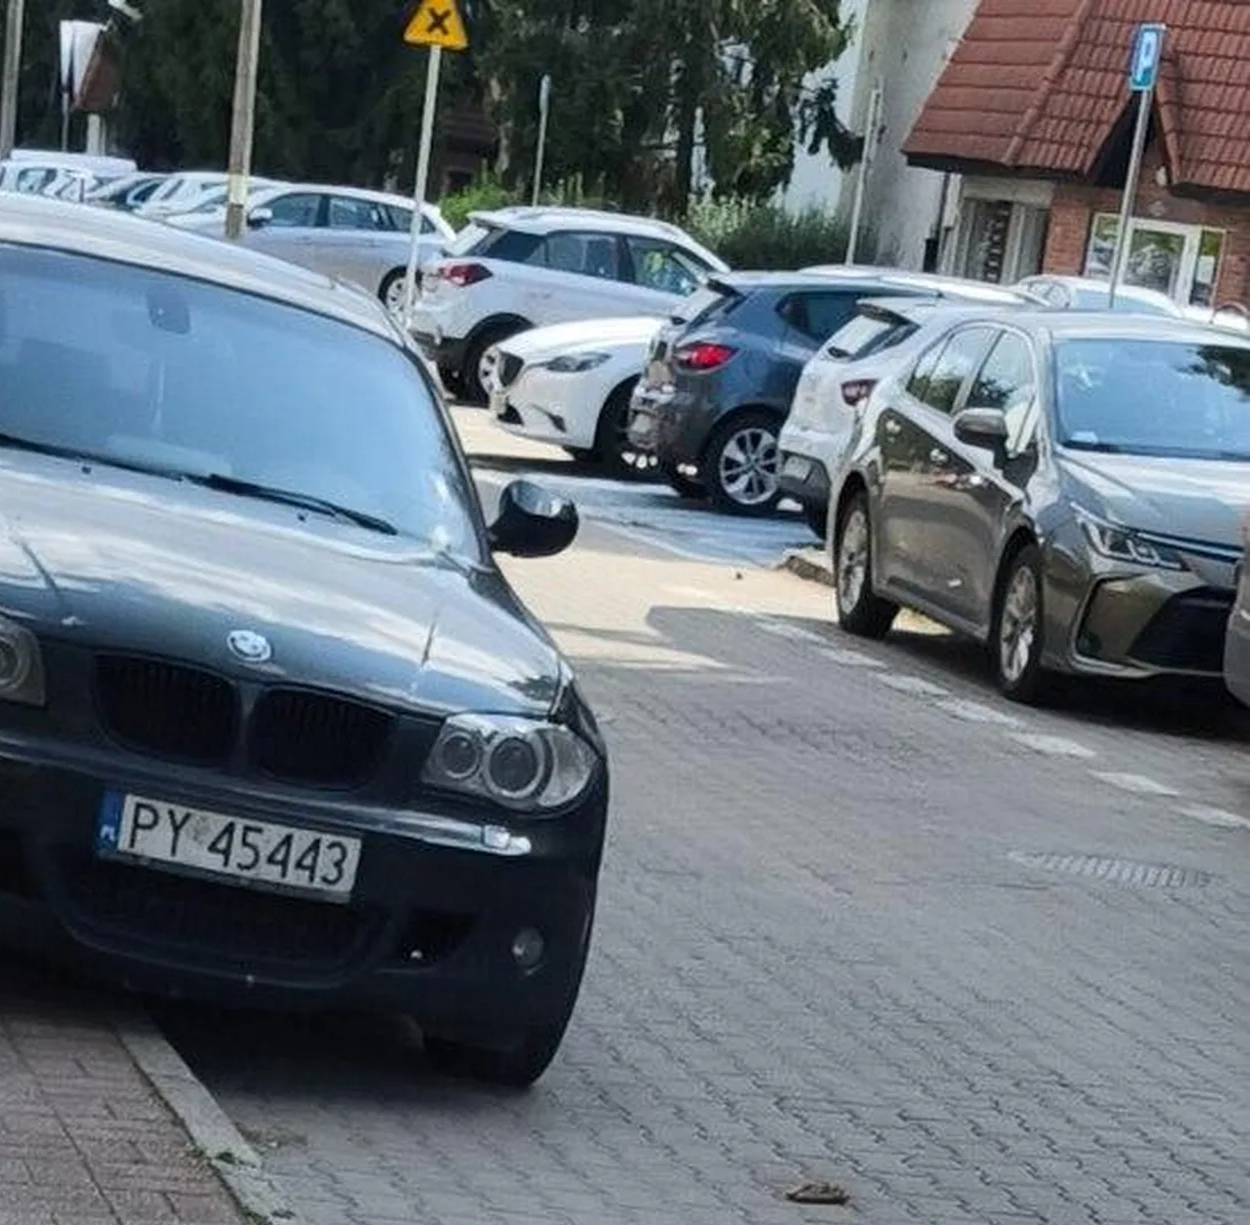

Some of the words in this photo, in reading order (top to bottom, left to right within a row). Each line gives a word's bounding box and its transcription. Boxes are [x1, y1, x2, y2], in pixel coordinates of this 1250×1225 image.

[1136, 31, 1157, 82] P
[129, 802, 191, 857] PY
[207, 821, 348, 886] 45443
